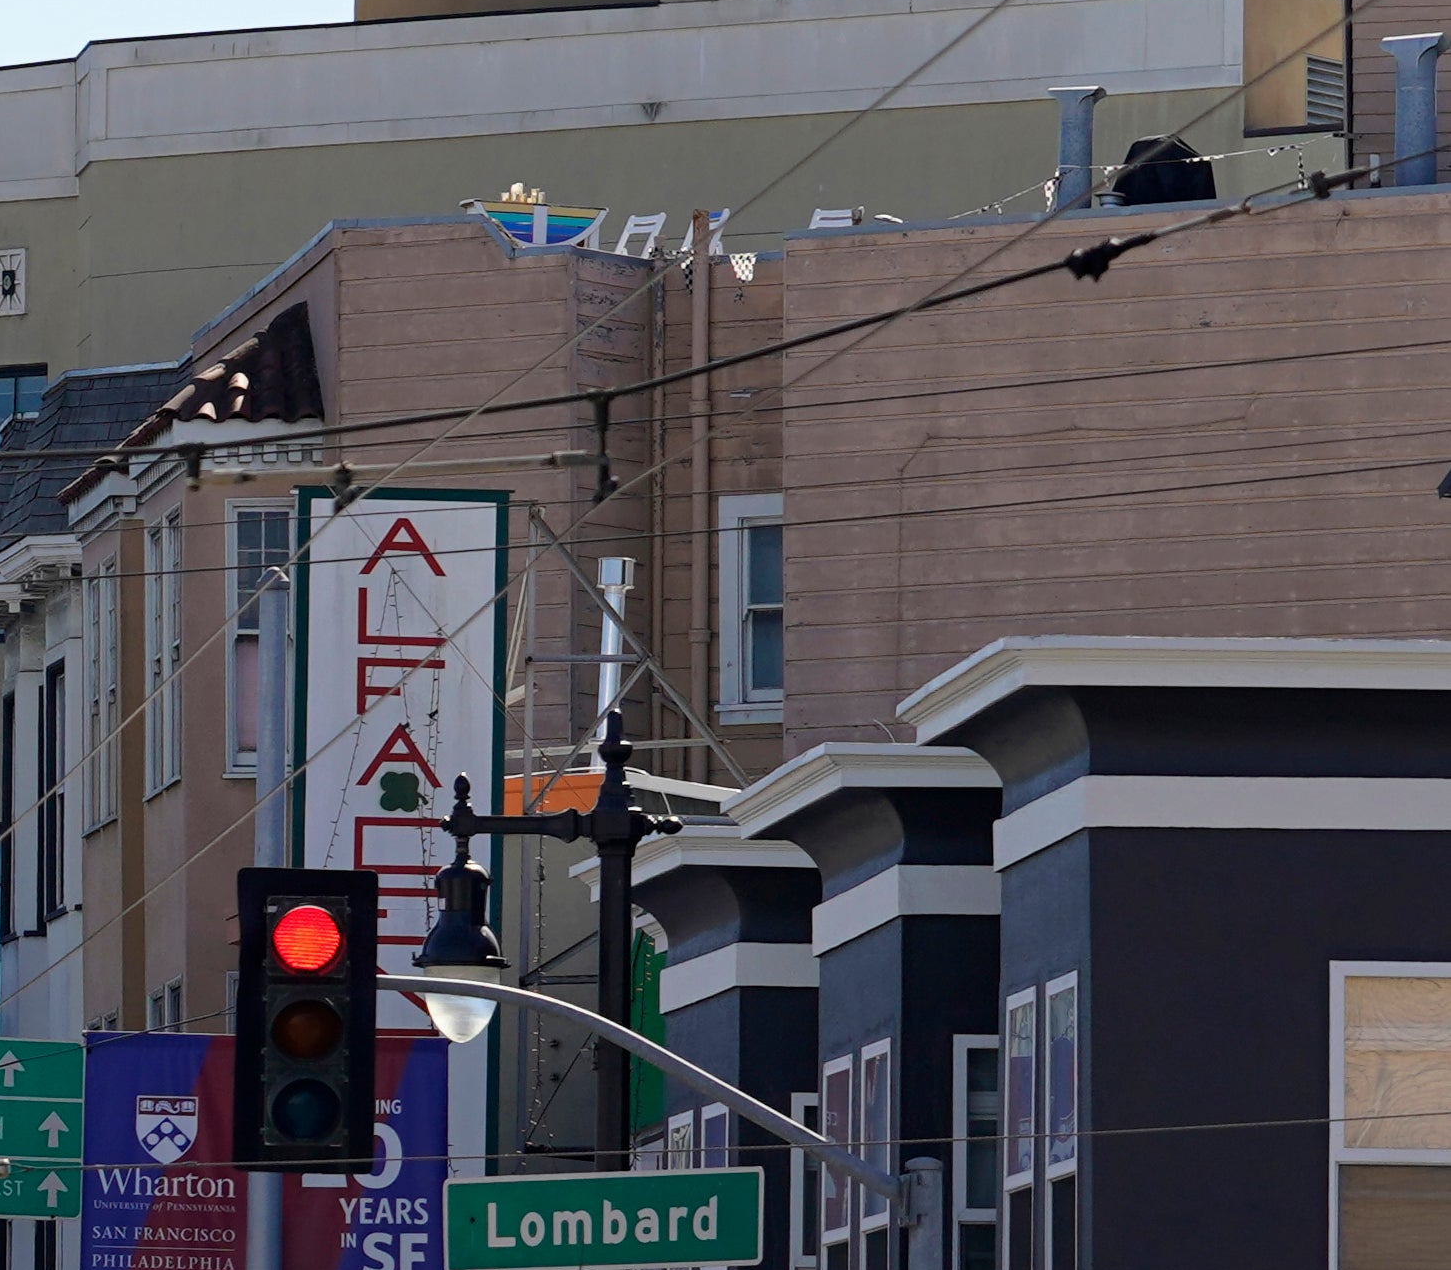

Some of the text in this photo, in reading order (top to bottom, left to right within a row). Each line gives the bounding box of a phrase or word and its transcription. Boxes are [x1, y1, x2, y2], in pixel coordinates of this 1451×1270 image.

[356, 516, 447, 789] ALFA
[97, 1166, 236, 1198] Wharton
[93, 1199, 236, 1213] UNIVERSITY of PENNSYLVANIA
[338, 1197, 429, 1225] YEARS
[92, 1225, 236, 1242] SAN FRANCISCO
[487, 1194, 718, 1248] Lombard
[340, 1232, 357, 1249] IN
